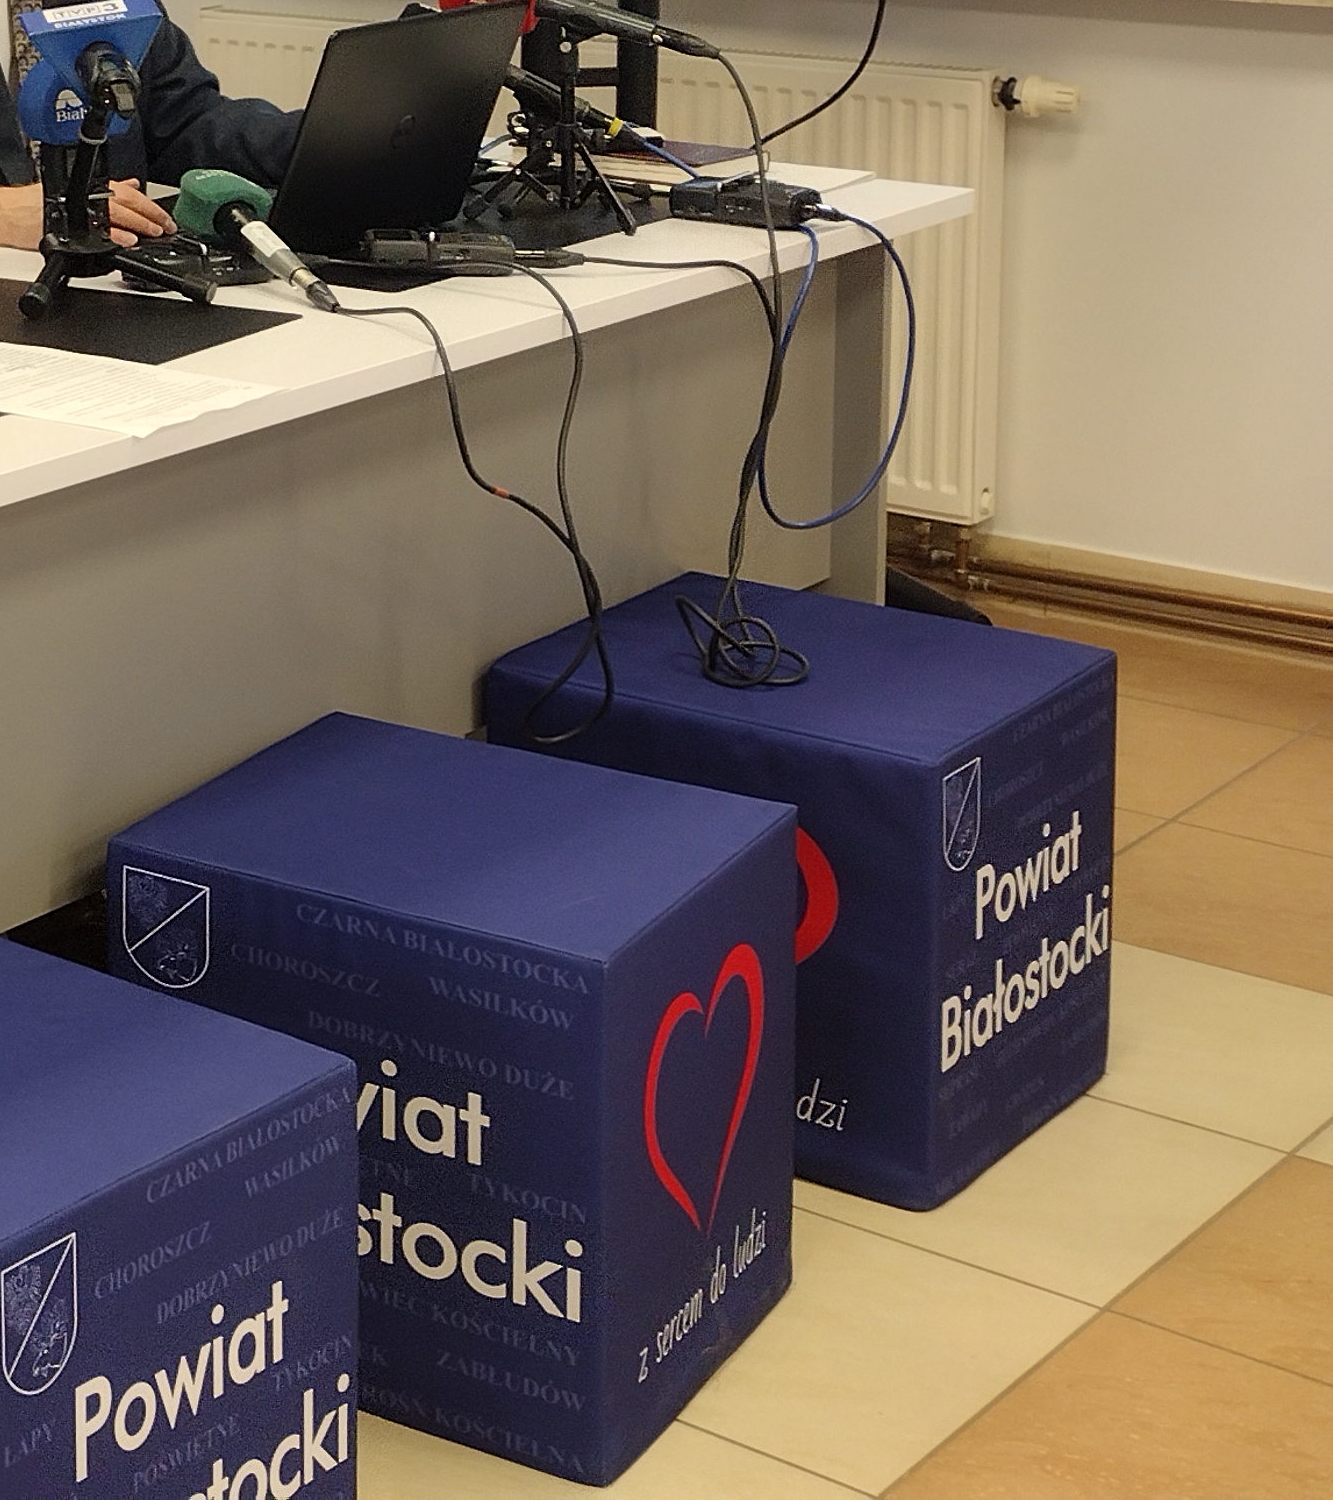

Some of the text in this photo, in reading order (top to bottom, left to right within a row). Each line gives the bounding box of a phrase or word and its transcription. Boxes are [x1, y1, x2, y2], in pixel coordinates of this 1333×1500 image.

[975, 810, 1083, 940] Powiat
[231, 942, 382, 998] CHOROSZCZ
[295, 902, 592, 995] CZARNA BIAŁOSTOCKA
[427, 975, 575, 1032] WASILKÓW
[940, 885, 1110, 1073] Białostocki
[637, 1205, 768, 1385] z sercem do ludzi
[75, 1280, 290, 1484] Powiat
